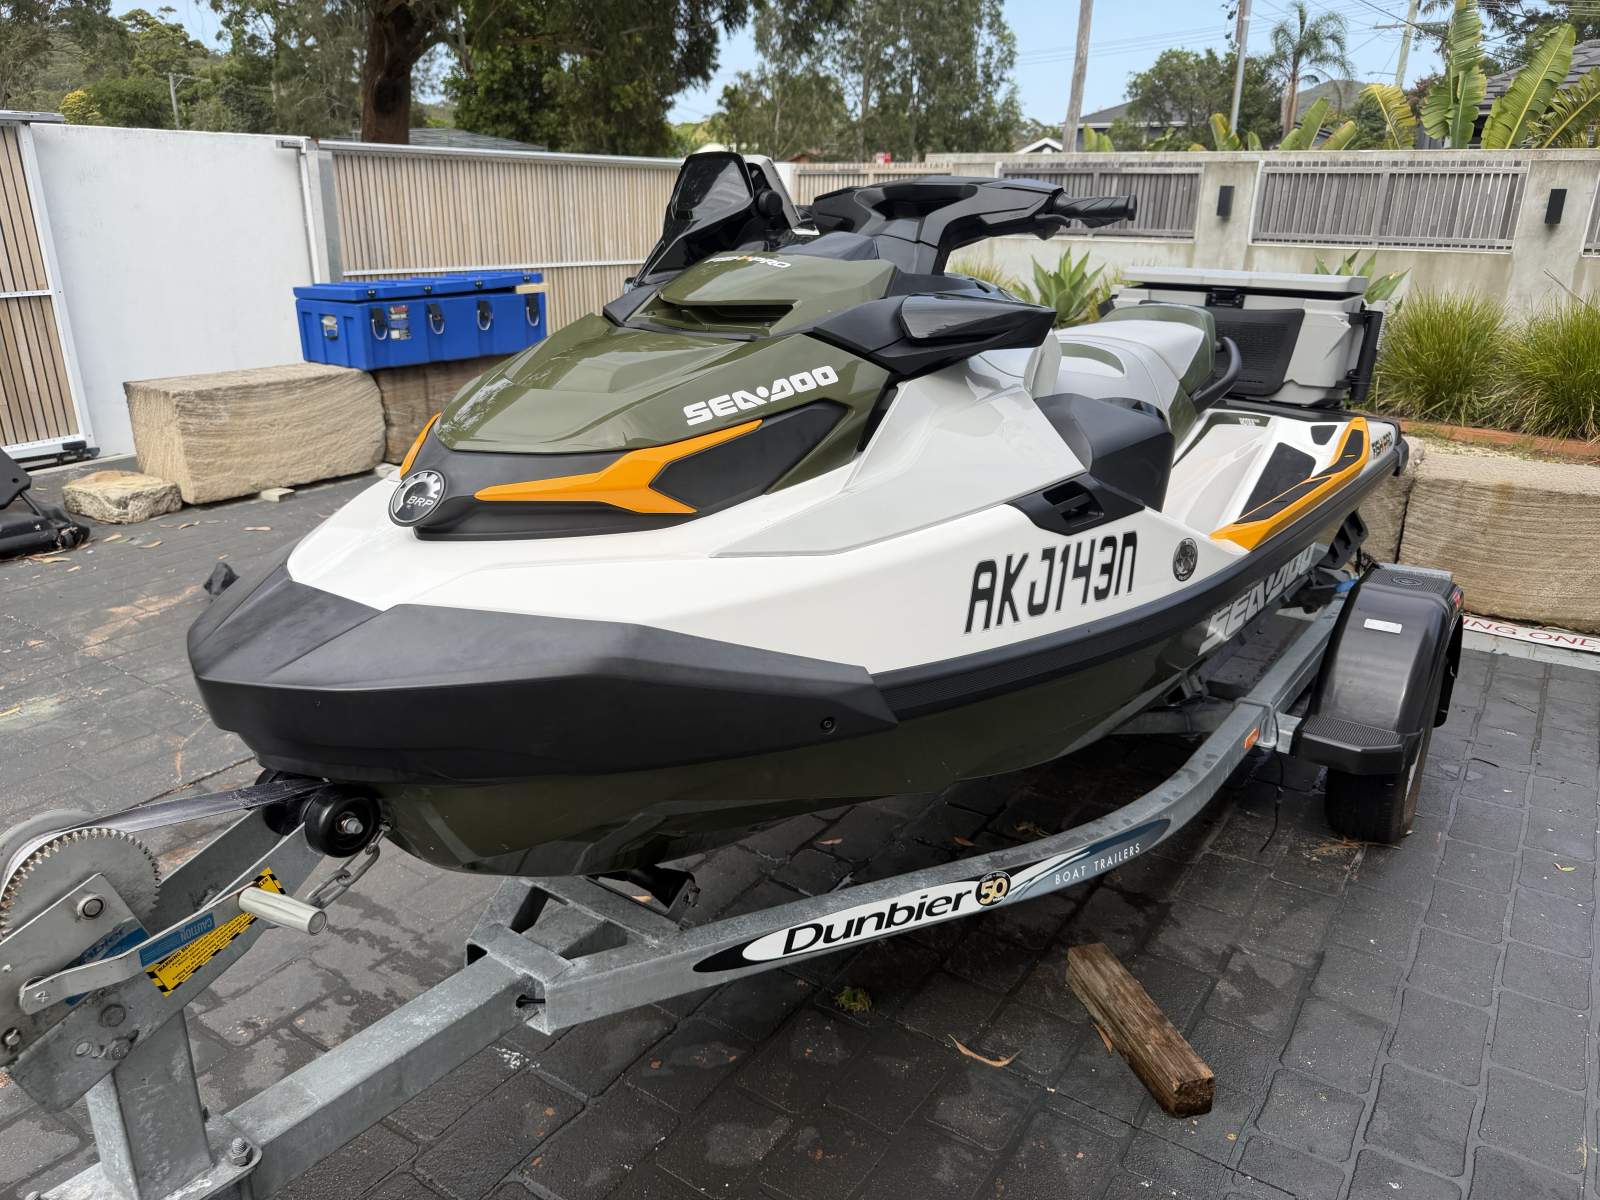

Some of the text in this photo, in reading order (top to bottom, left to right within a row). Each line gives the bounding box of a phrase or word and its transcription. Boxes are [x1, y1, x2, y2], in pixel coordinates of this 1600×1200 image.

[407, 496, 434, 507] BRP
[1055, 843, 1140, 885] BOAT TRAILERS
[783, 877, 1008, 955] Dunbier 50
